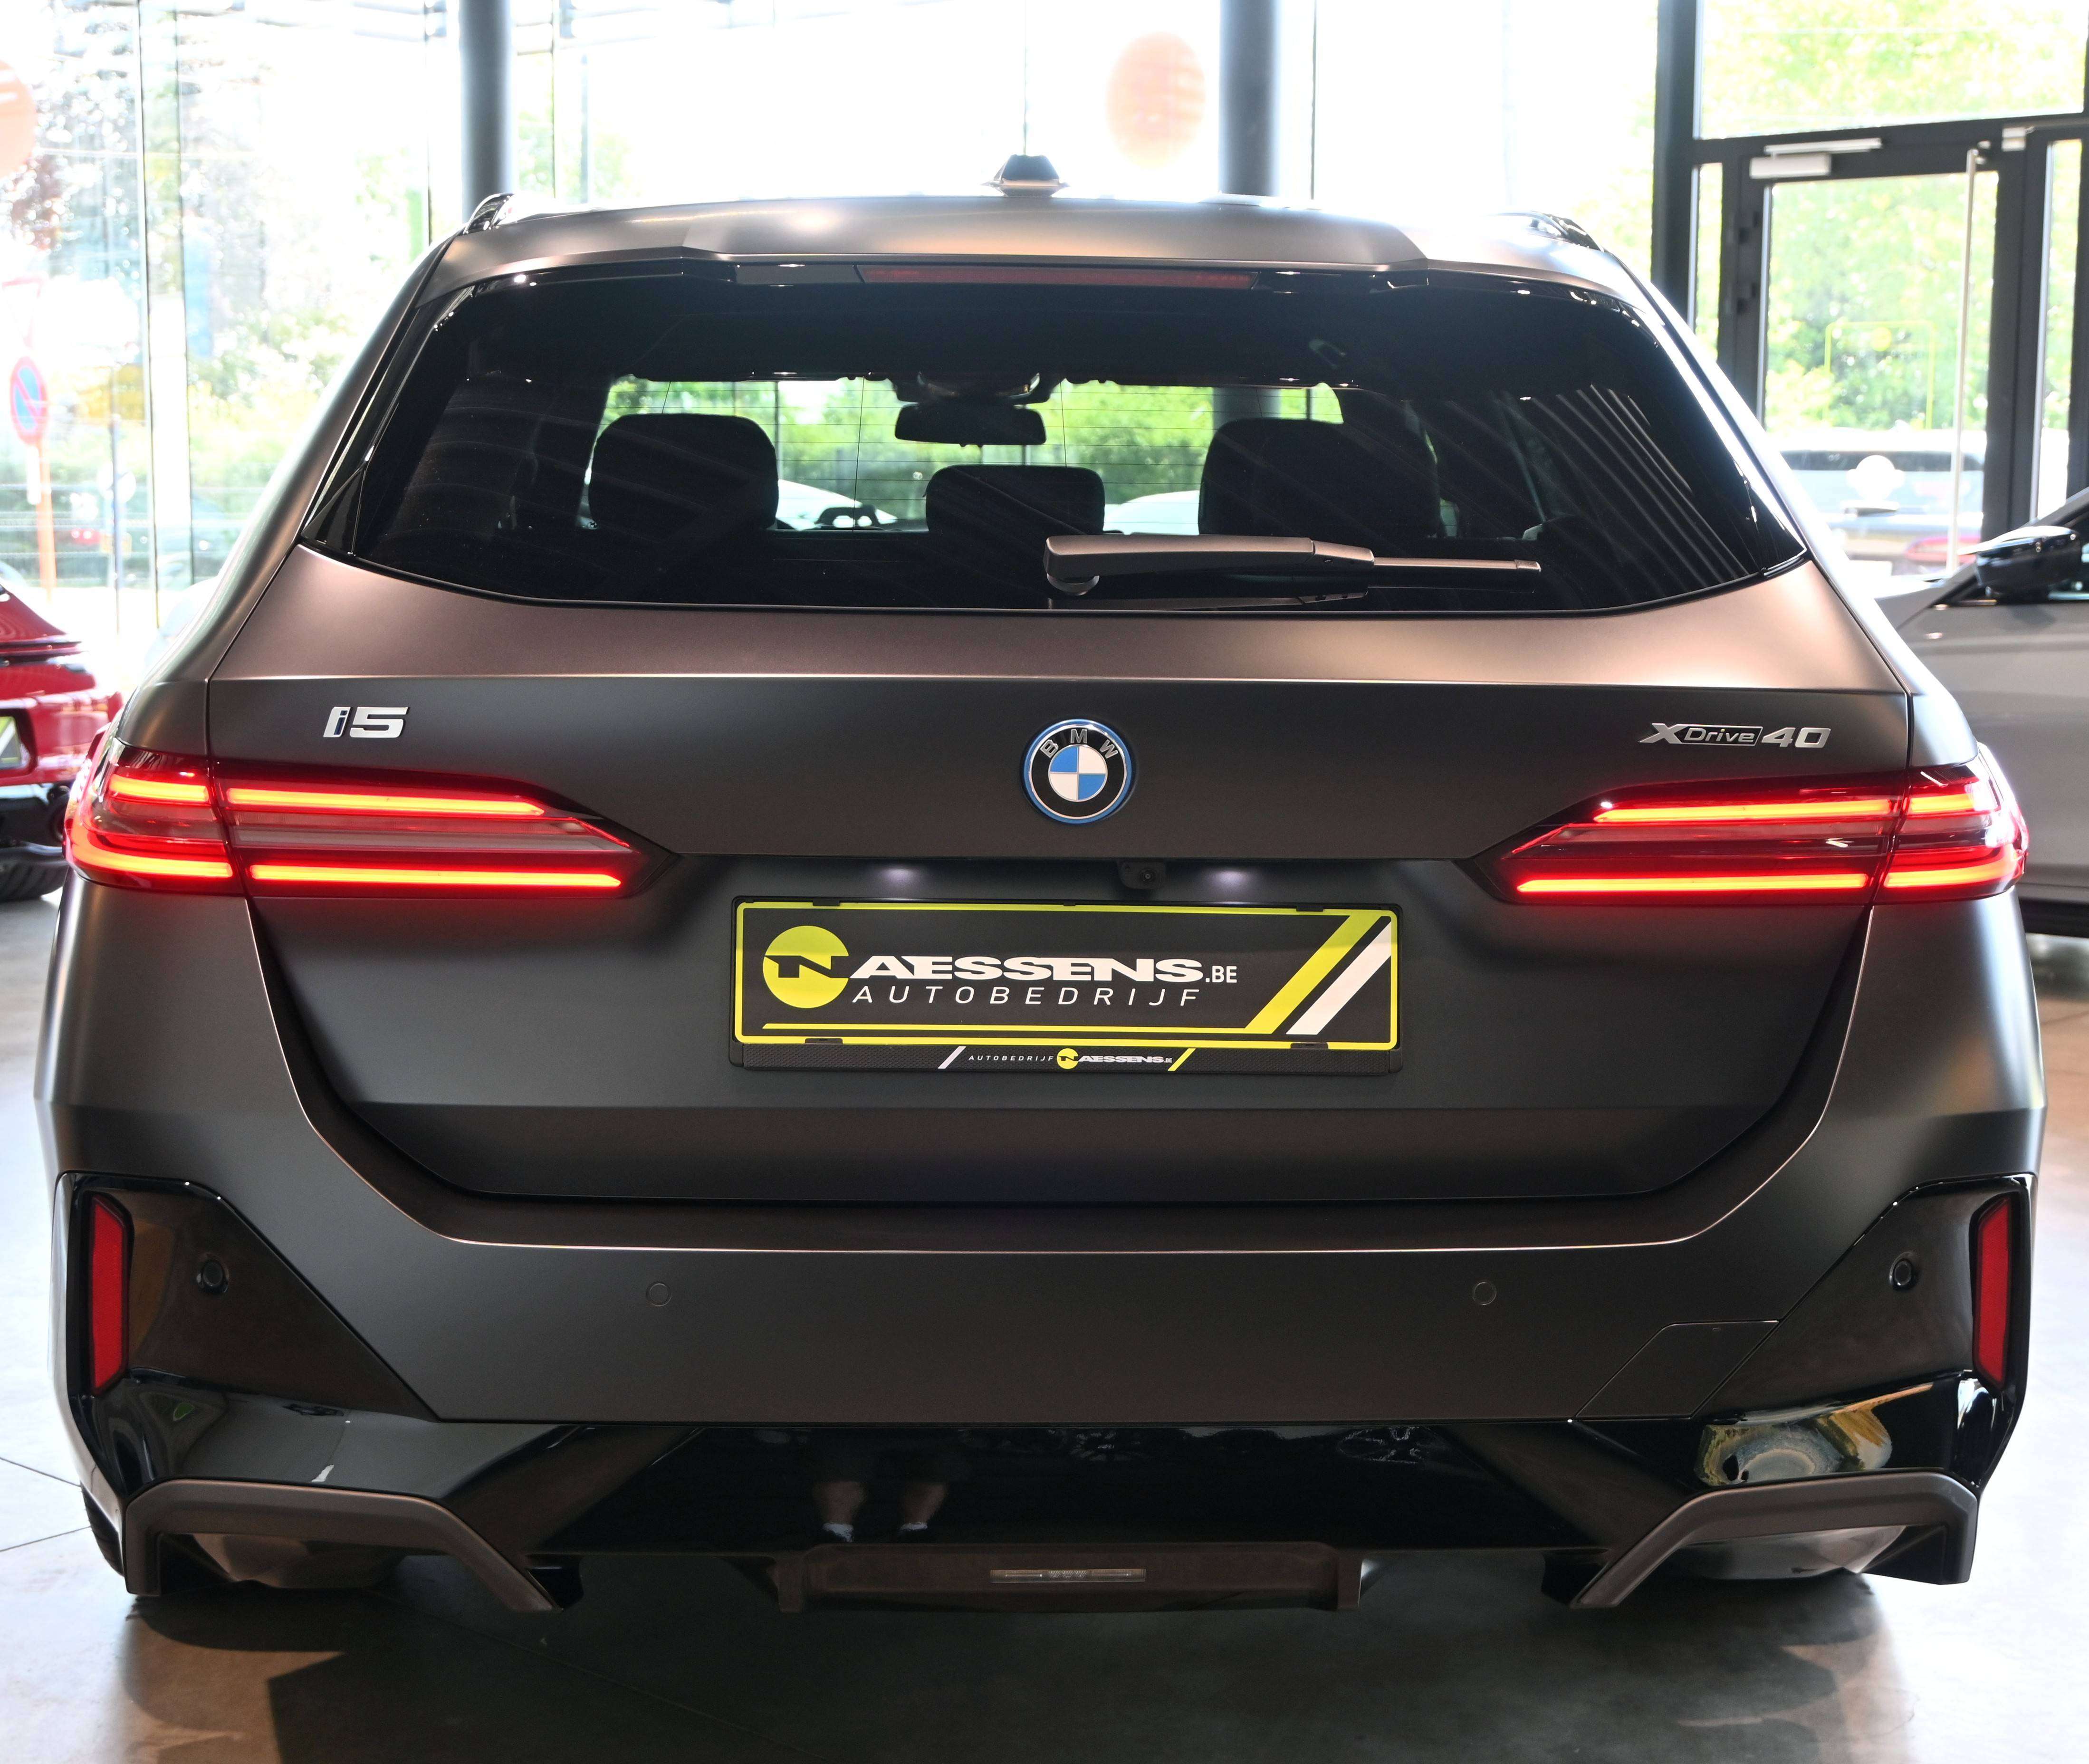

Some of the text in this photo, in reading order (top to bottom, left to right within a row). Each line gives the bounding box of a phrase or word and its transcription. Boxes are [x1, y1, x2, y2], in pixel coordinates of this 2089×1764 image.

[323, 706, 408, 738] i5
[1040, 729, 1119, 759] BMW
[852, 985, 1200, 1007] AUTOBEDRIJF
